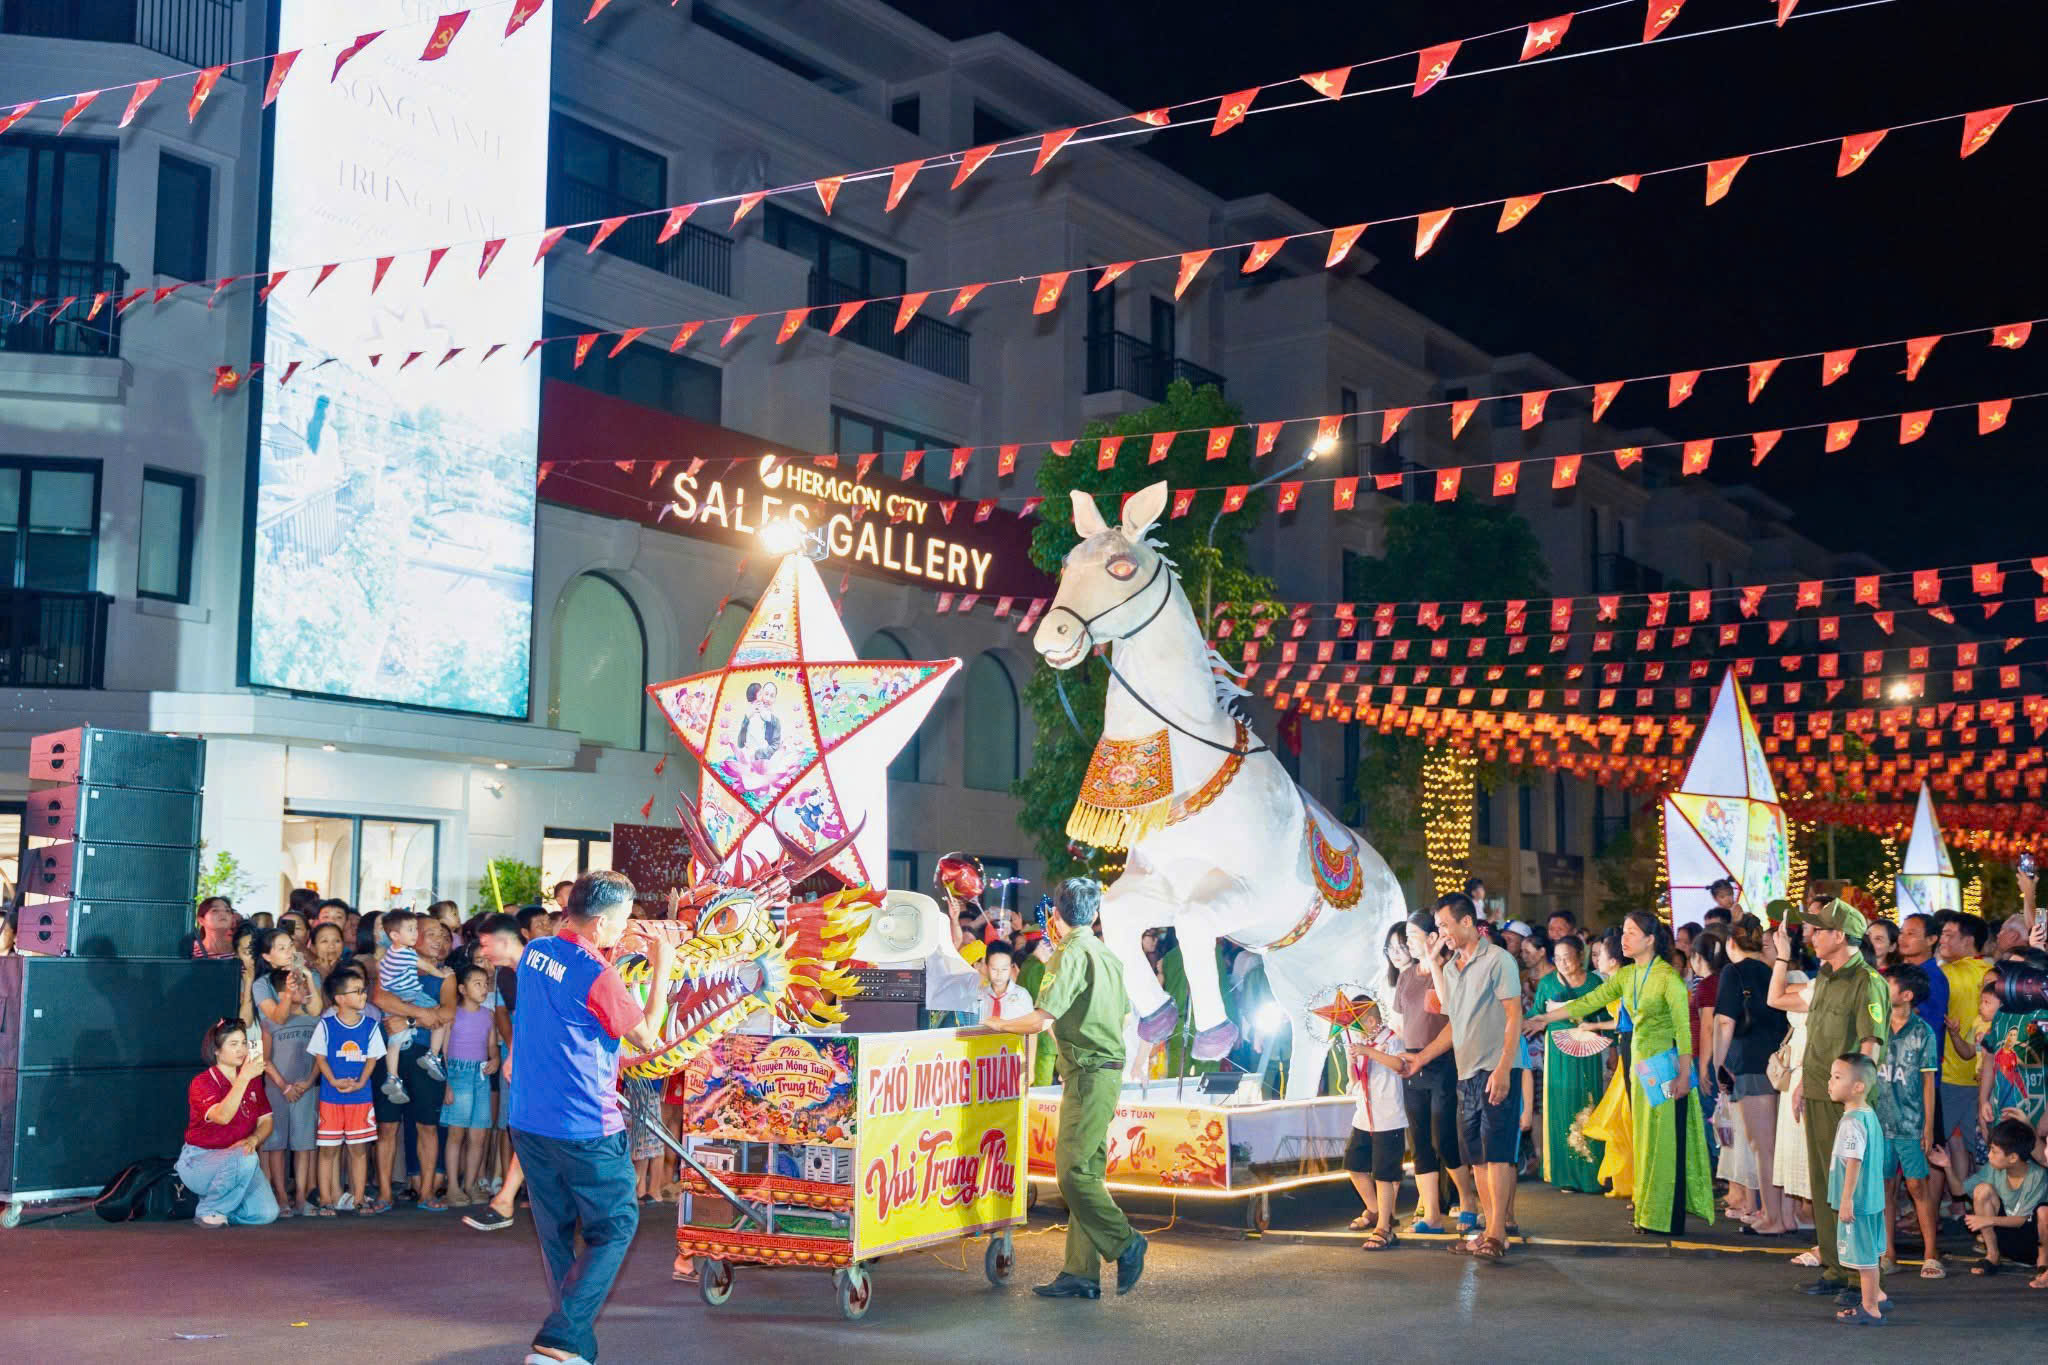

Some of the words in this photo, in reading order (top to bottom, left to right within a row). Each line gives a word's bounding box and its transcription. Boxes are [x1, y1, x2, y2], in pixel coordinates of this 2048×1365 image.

[787, 465, 881, 512] HERAGON
[886, 494, 928, 524] CTY
[829, 514, 993, 590] GALLERY
[545, 959, 567, 983] NAM
[757, 1080, 775, 1096] Vui
[775, 1077, 805, 1097] Trung
[807, 1080, 828, 1096] thu
[869, 1049, 910, 1115] PHỐ
[913, 1052, 971, 1116] MỘNG
[976, 1046, 1021, 1101] TUÂN
[1032, 1116, 1056, 1154] Vu
[865, 1144, 917, 1220] Vui
[918, 1130, 980, 1205] Trung
[980, 1129, 1015, 1197] Thu
